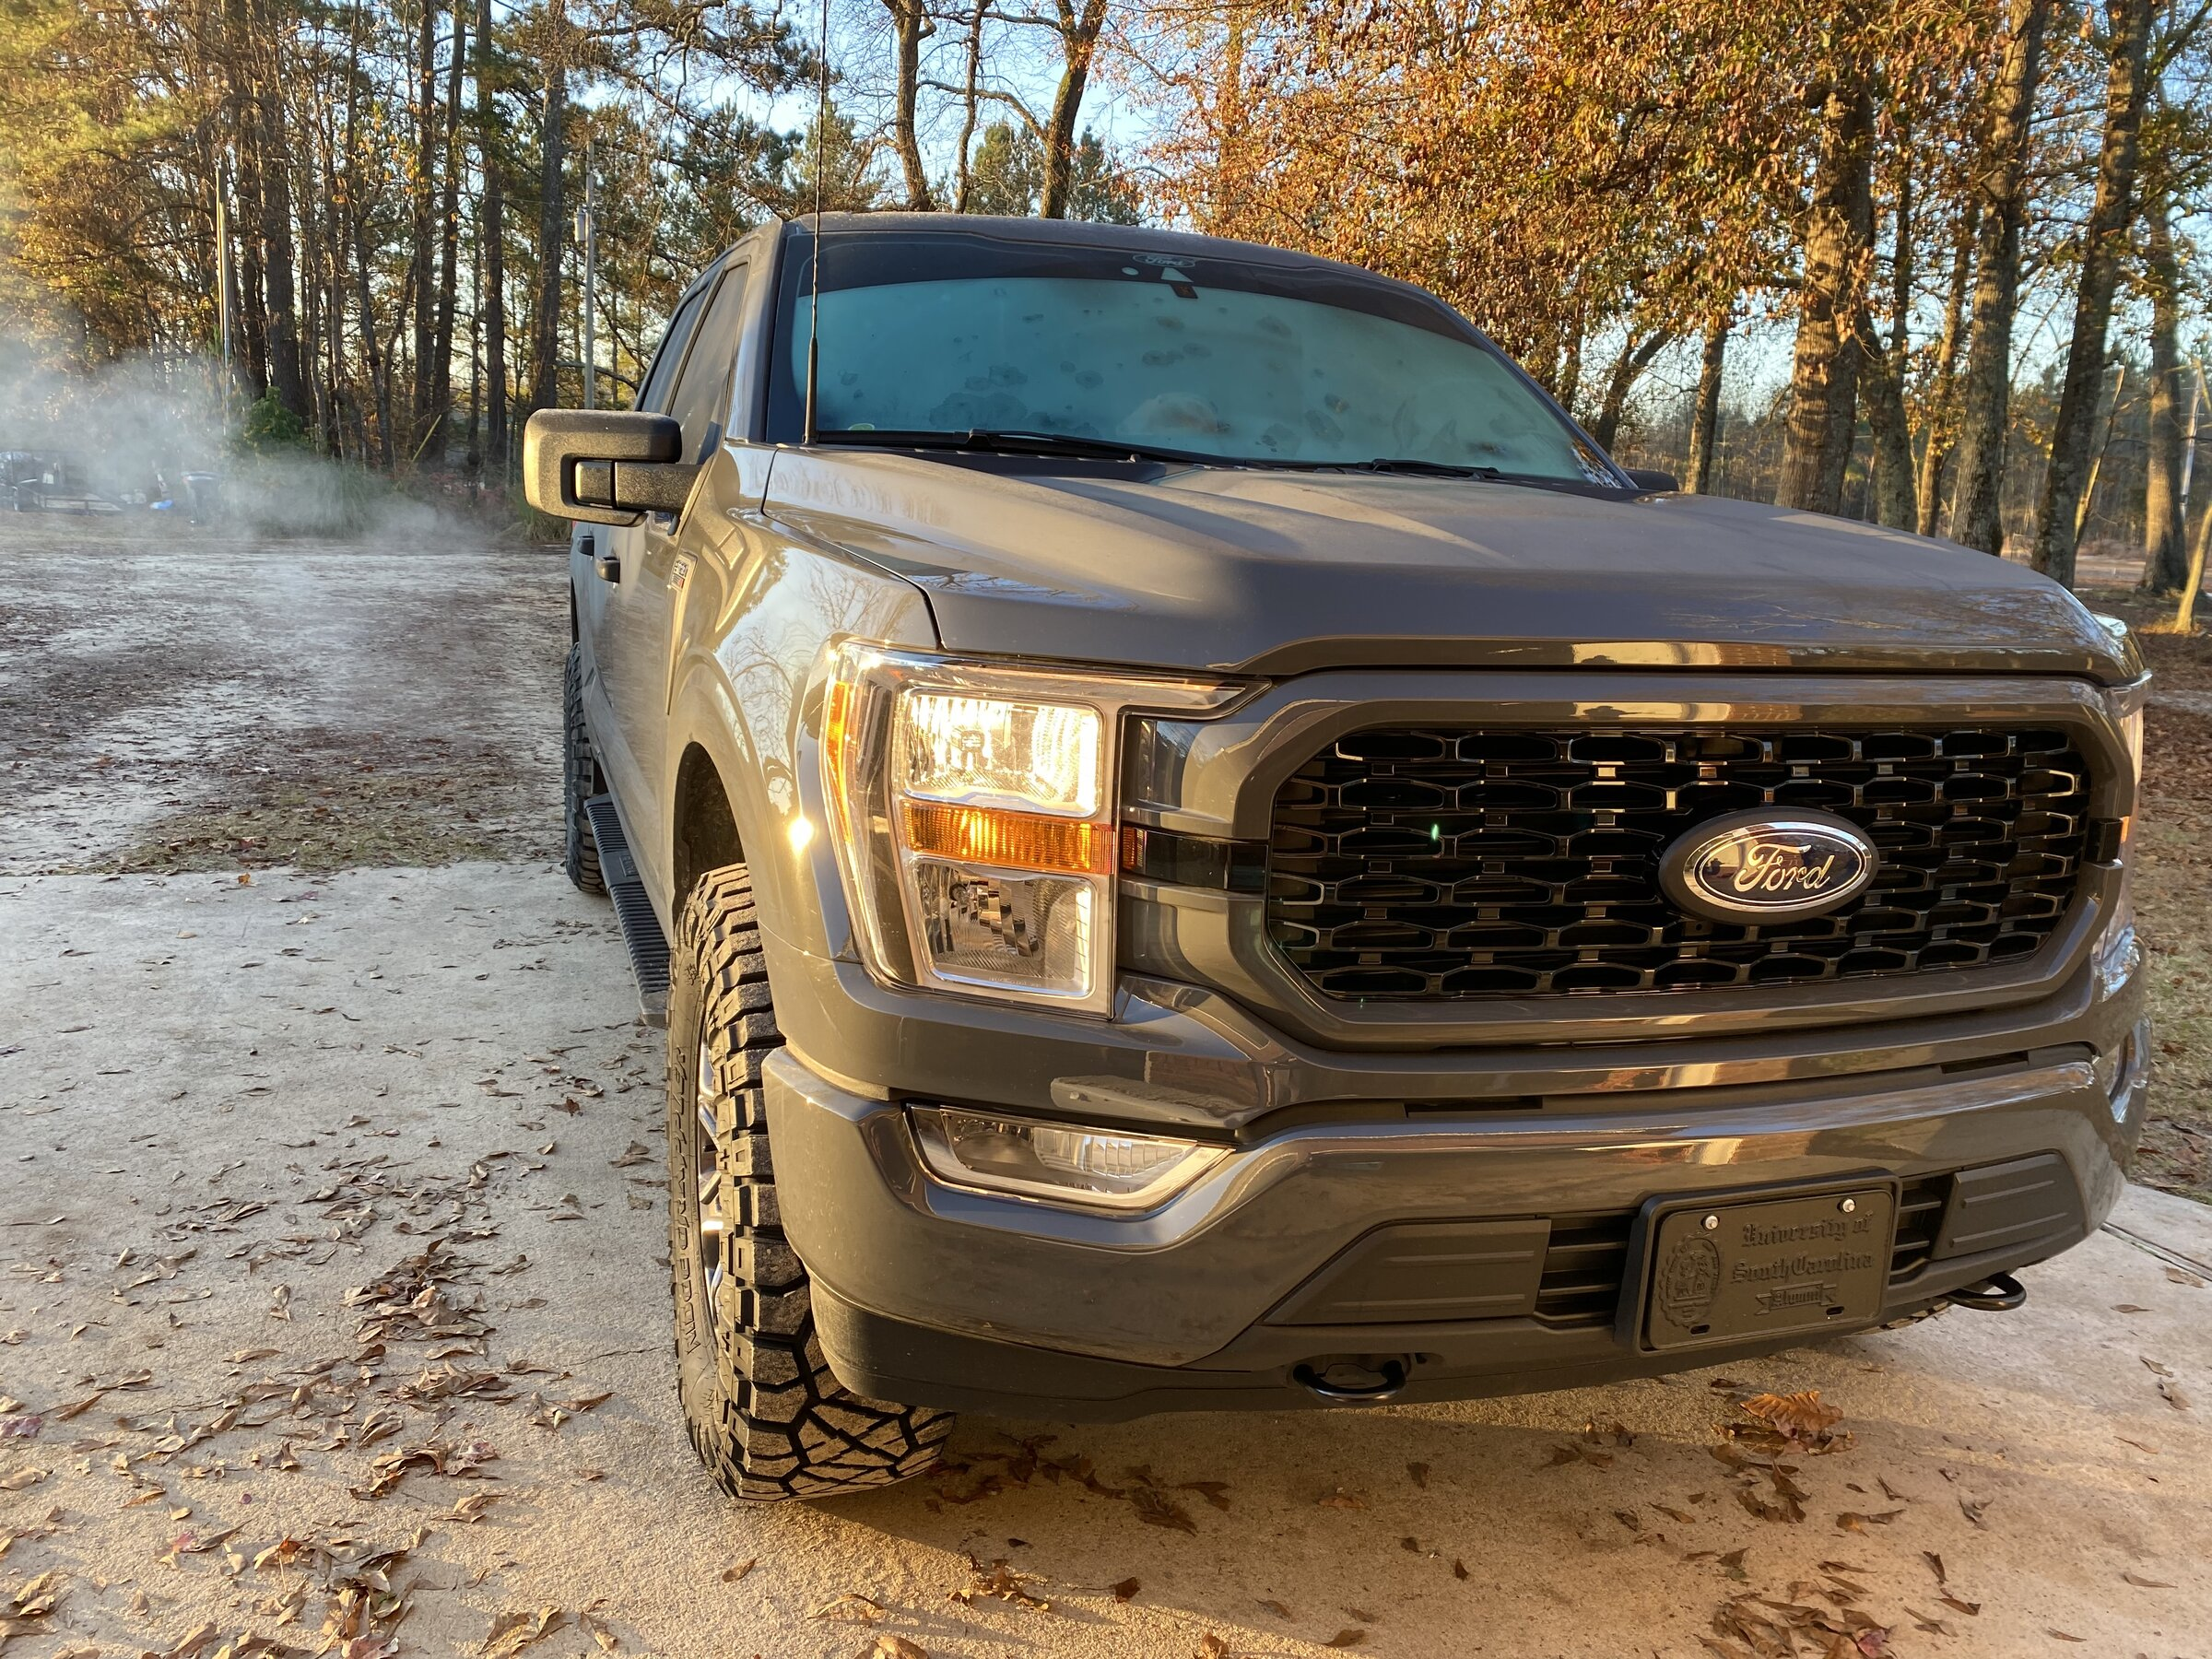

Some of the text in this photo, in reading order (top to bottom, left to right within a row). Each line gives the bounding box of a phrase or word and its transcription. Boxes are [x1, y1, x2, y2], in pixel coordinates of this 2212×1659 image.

[1734, 842, 1836, 893] Ford
[1741, 1209, 1875, 1248] University of
[1730, 1249, 1874, 1284] South Carolina
